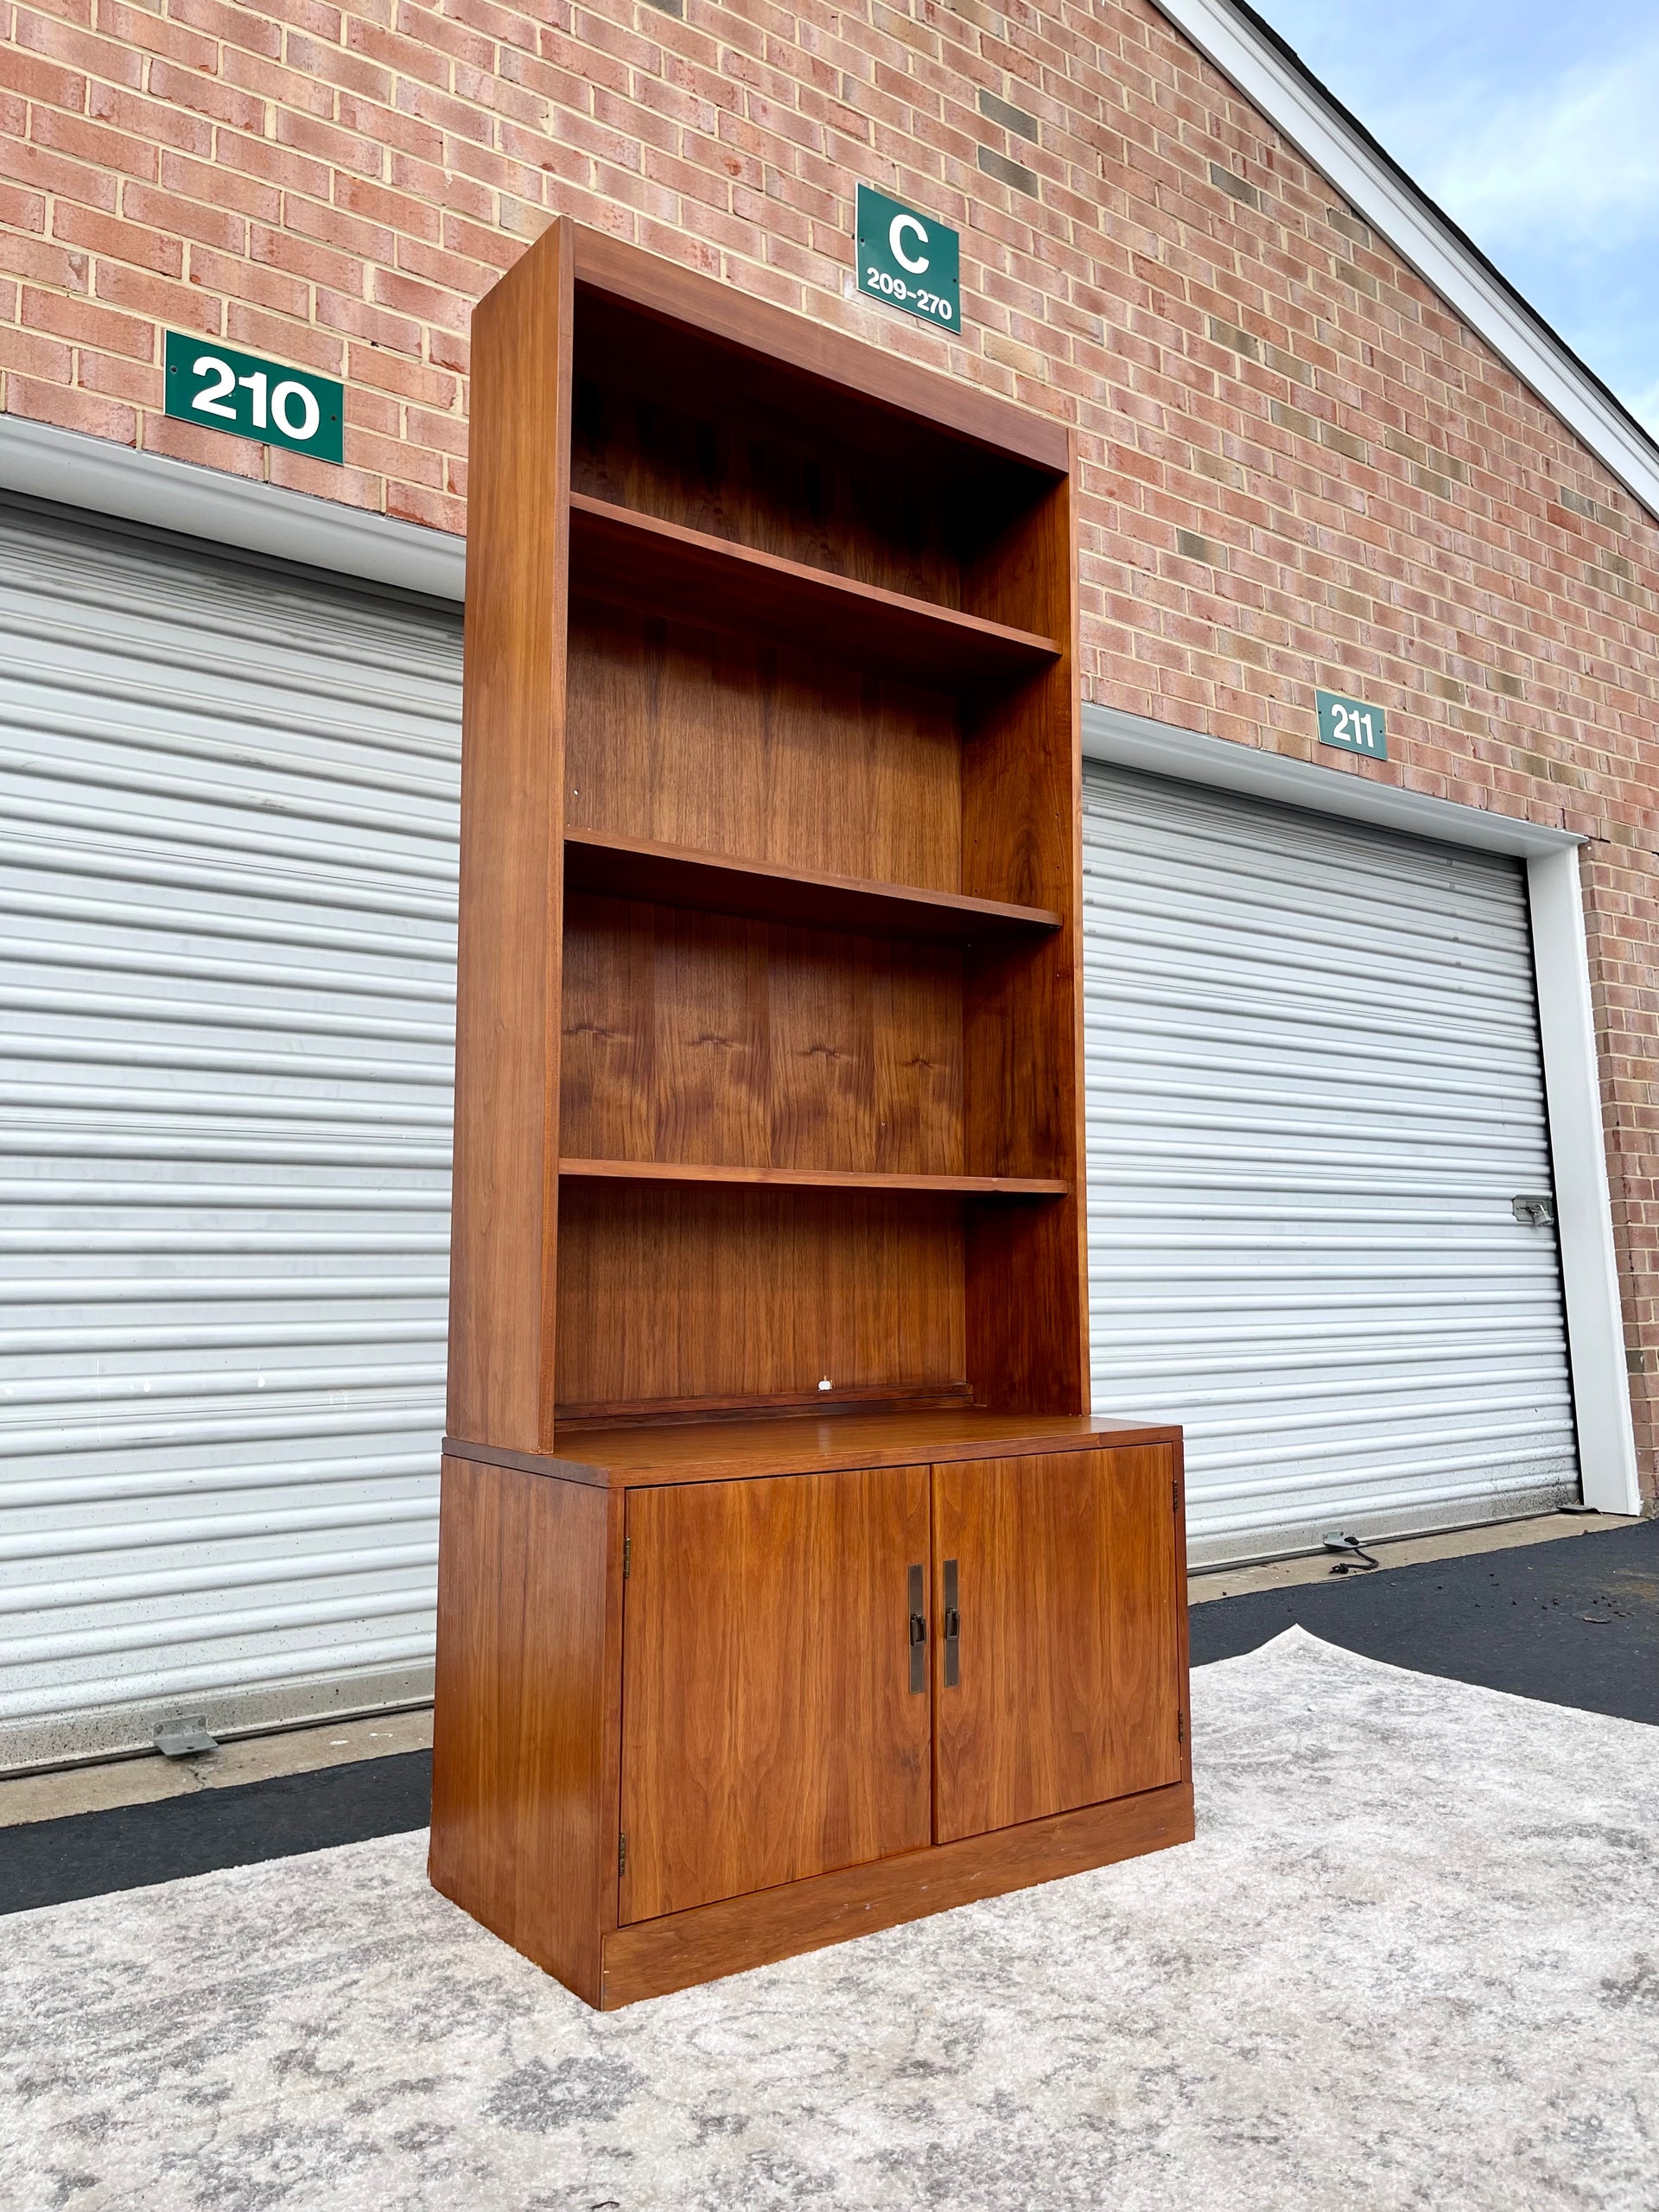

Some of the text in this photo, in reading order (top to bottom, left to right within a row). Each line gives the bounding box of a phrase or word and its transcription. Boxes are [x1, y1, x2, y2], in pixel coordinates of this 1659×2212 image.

[889, 214, 930, 275] C
[867, 267, 953, 321] 209-270
[191, 356, 320, 441] 210
[1331, 703, 1374, 748] 211
